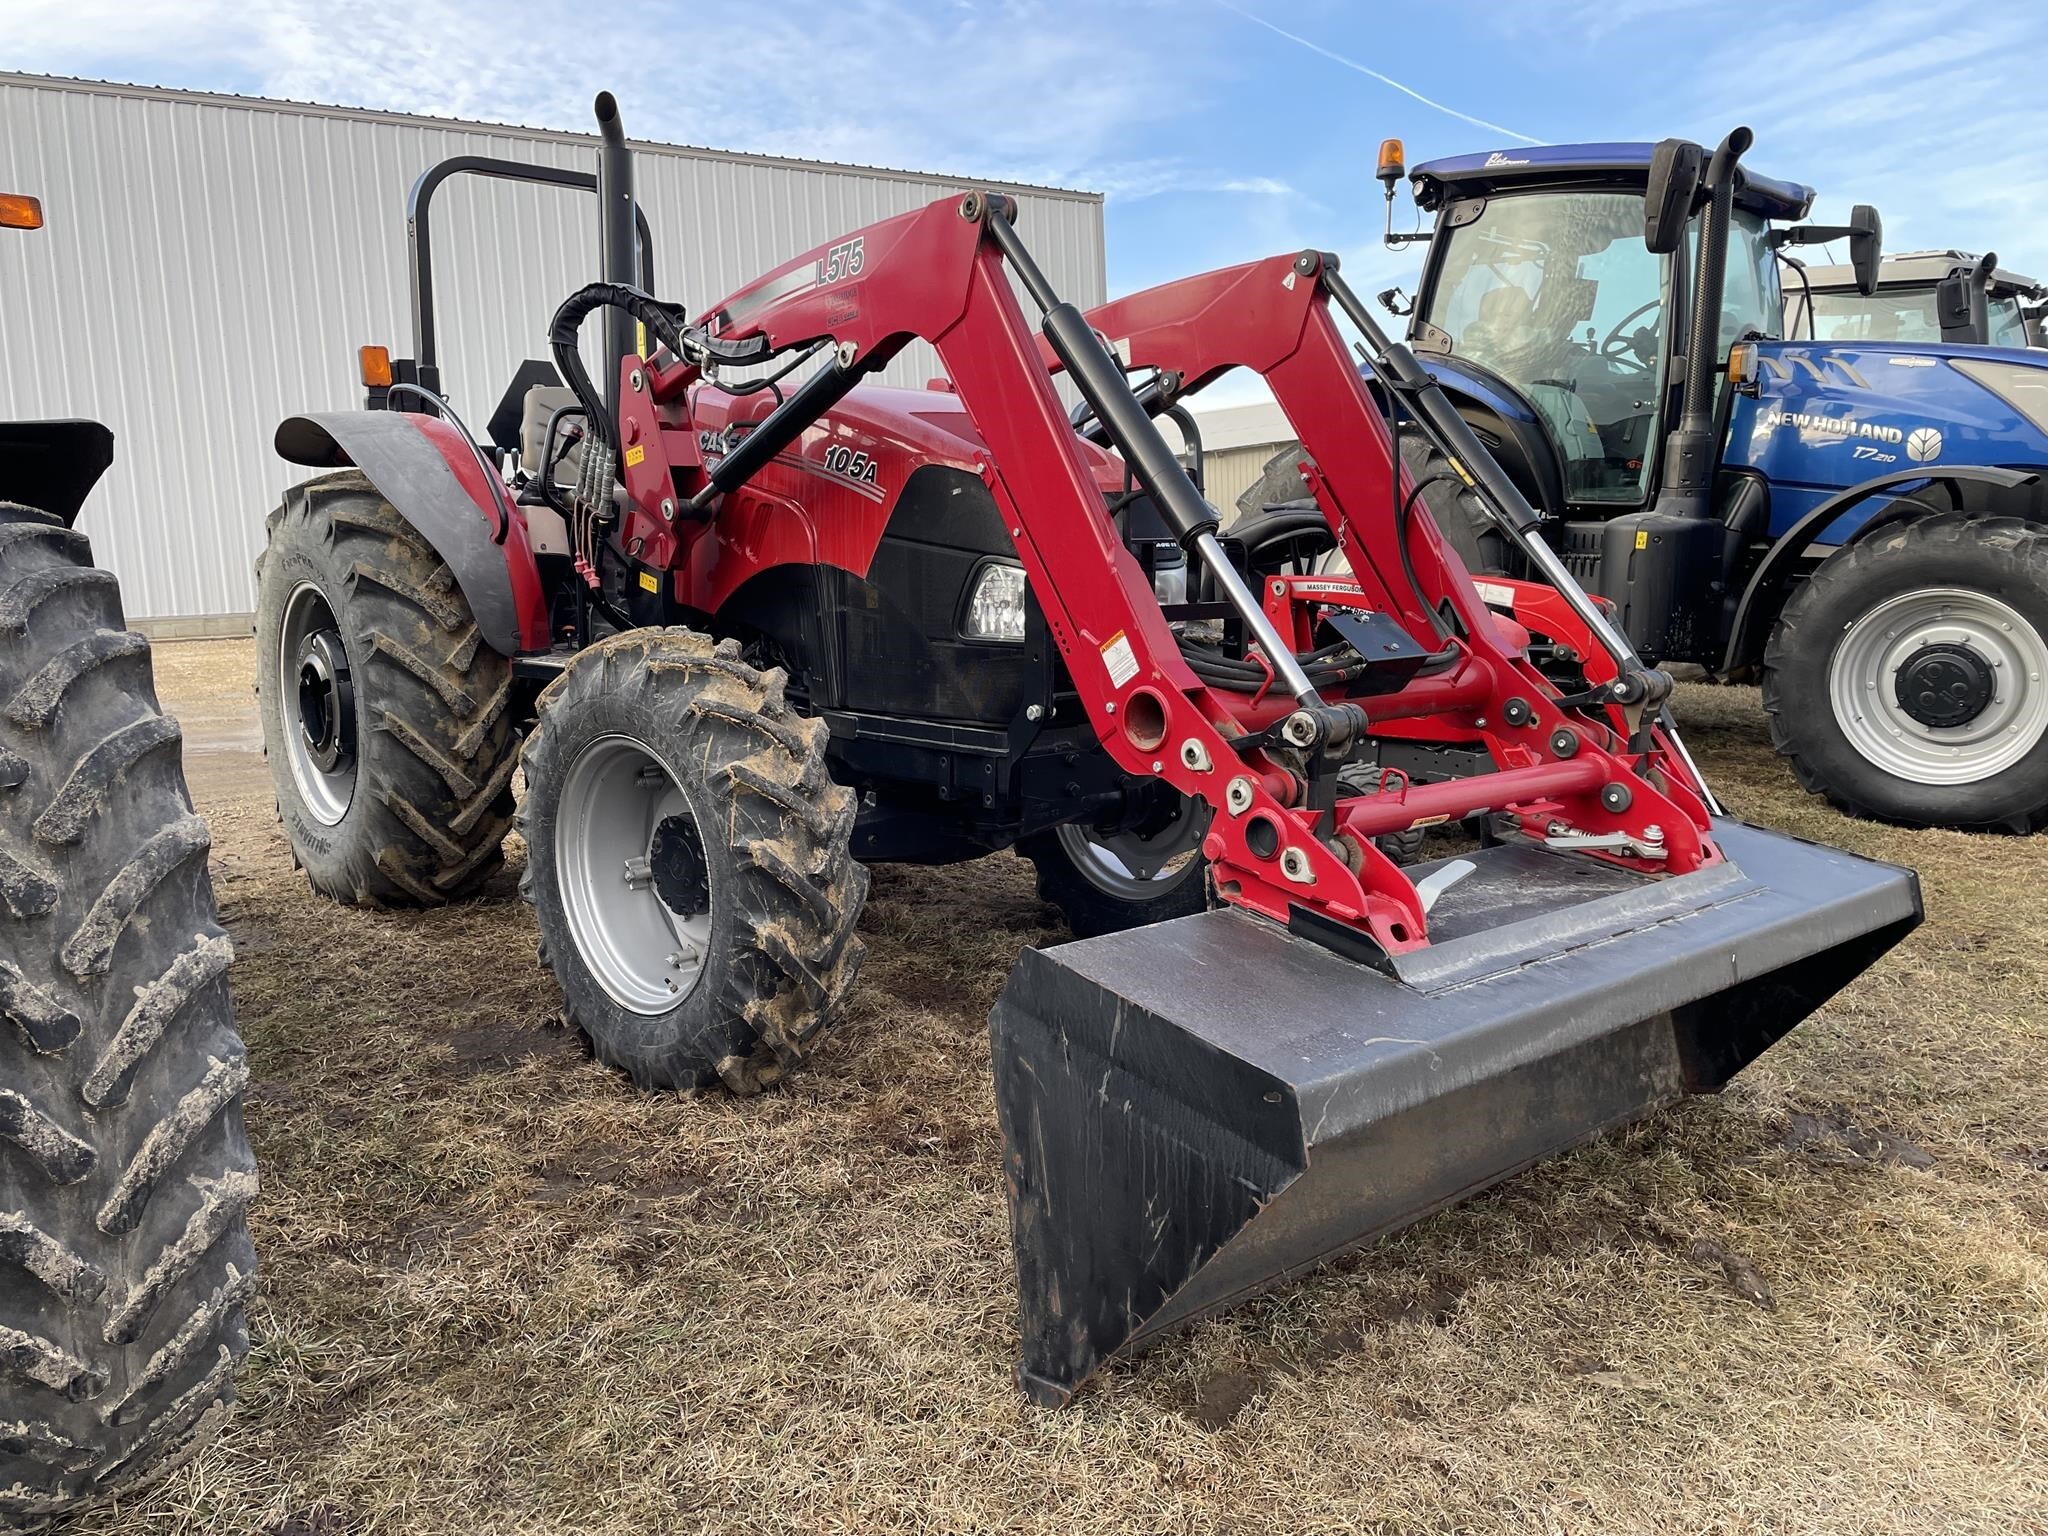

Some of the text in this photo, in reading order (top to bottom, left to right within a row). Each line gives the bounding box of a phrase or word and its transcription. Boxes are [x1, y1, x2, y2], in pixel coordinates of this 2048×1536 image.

[816, 236, 864, 287] L575
[1767, 411, 1903, 444] NEW HOLLAND
[824, 444, 878, 484] 105A
